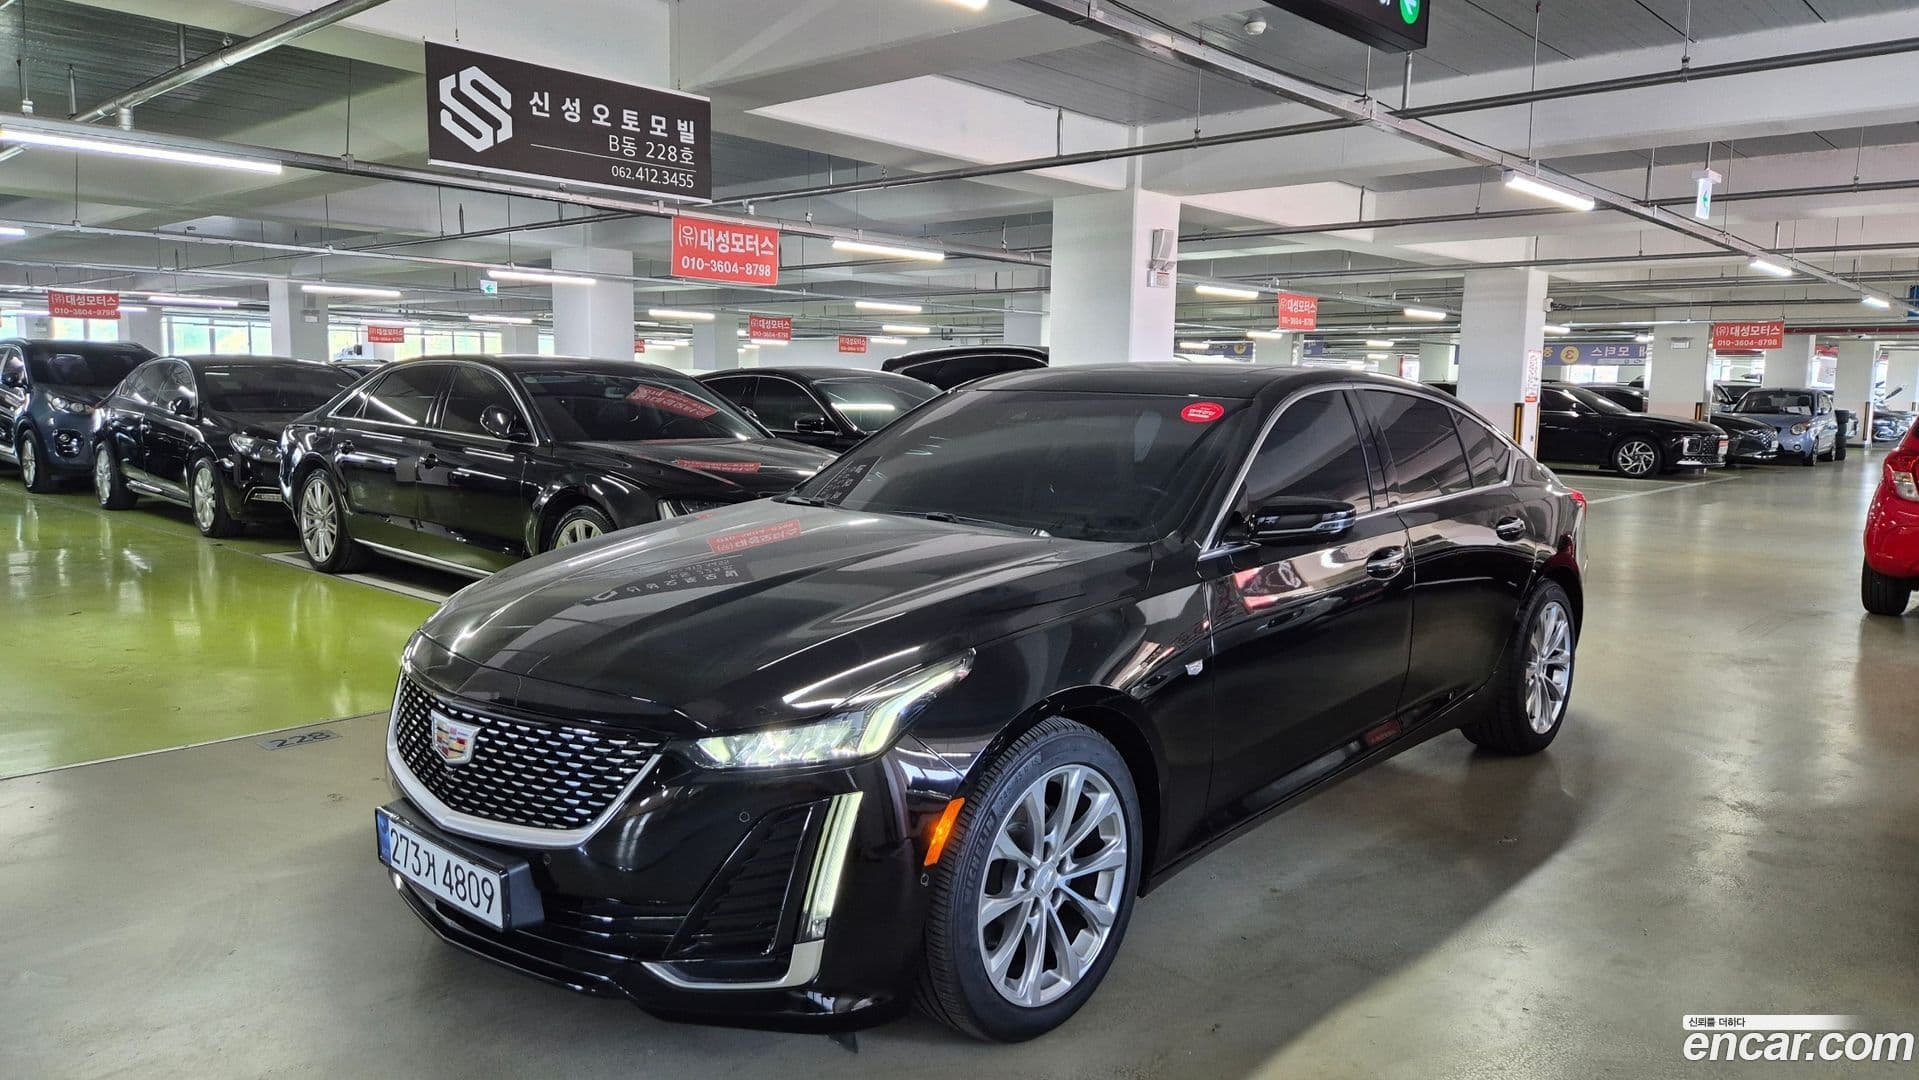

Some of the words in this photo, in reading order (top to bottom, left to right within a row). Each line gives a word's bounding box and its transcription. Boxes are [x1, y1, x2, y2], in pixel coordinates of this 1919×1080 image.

[529, 91, 695, 145] 신성오토모빌
[609, 134, 637, 157] B동
[645, 141, 695, 165] 228호
[611, 165, 694, 188] 062.412.3455
[678, 223, 775, 256] (유)대성모터스
[681, 255, 771, 277] 010-3604-8798
[1715, 324, 1780, 337] (유)대성모터스
[443, 859, 495, 914] 4809
